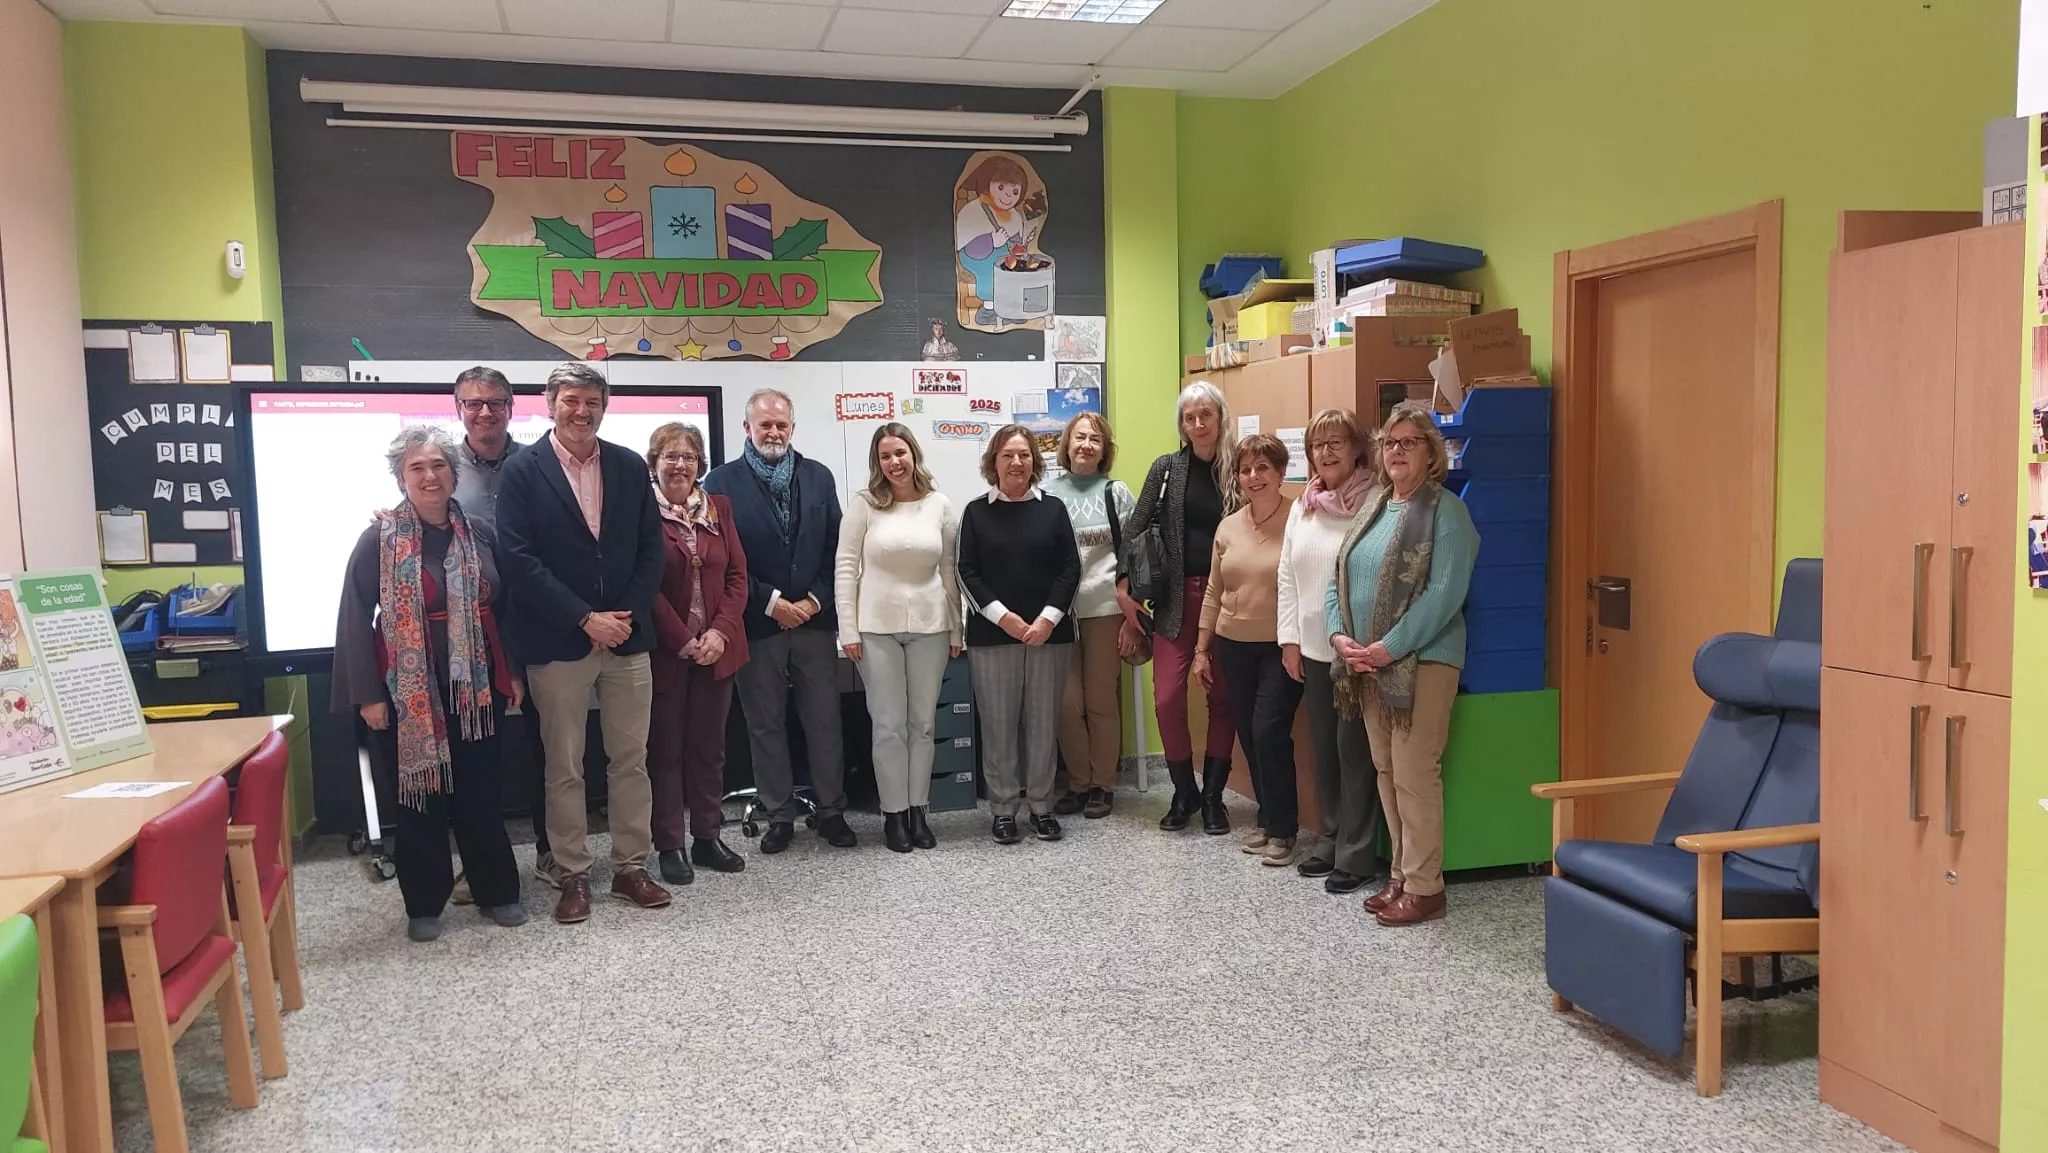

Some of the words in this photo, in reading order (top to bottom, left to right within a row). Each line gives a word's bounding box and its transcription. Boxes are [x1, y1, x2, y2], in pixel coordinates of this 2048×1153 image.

[456, 132, 626, 180] FELIZ
[552, 269, 818, 310] NAVIDAD
[918, 384, 962, 392] DICIEMBRE
[845, 397, 885, 413] Lunes
[969, 399, 1001, 411] 2025
[107, 405, 216, 437] CUMPL
[161, 445, 218, 458] DEL
[158, 482, 226, 498] MES
[60, 582, 84, 592] cosas
[41, 598, 53, 606] de
[54, 596, 62, 605] la
